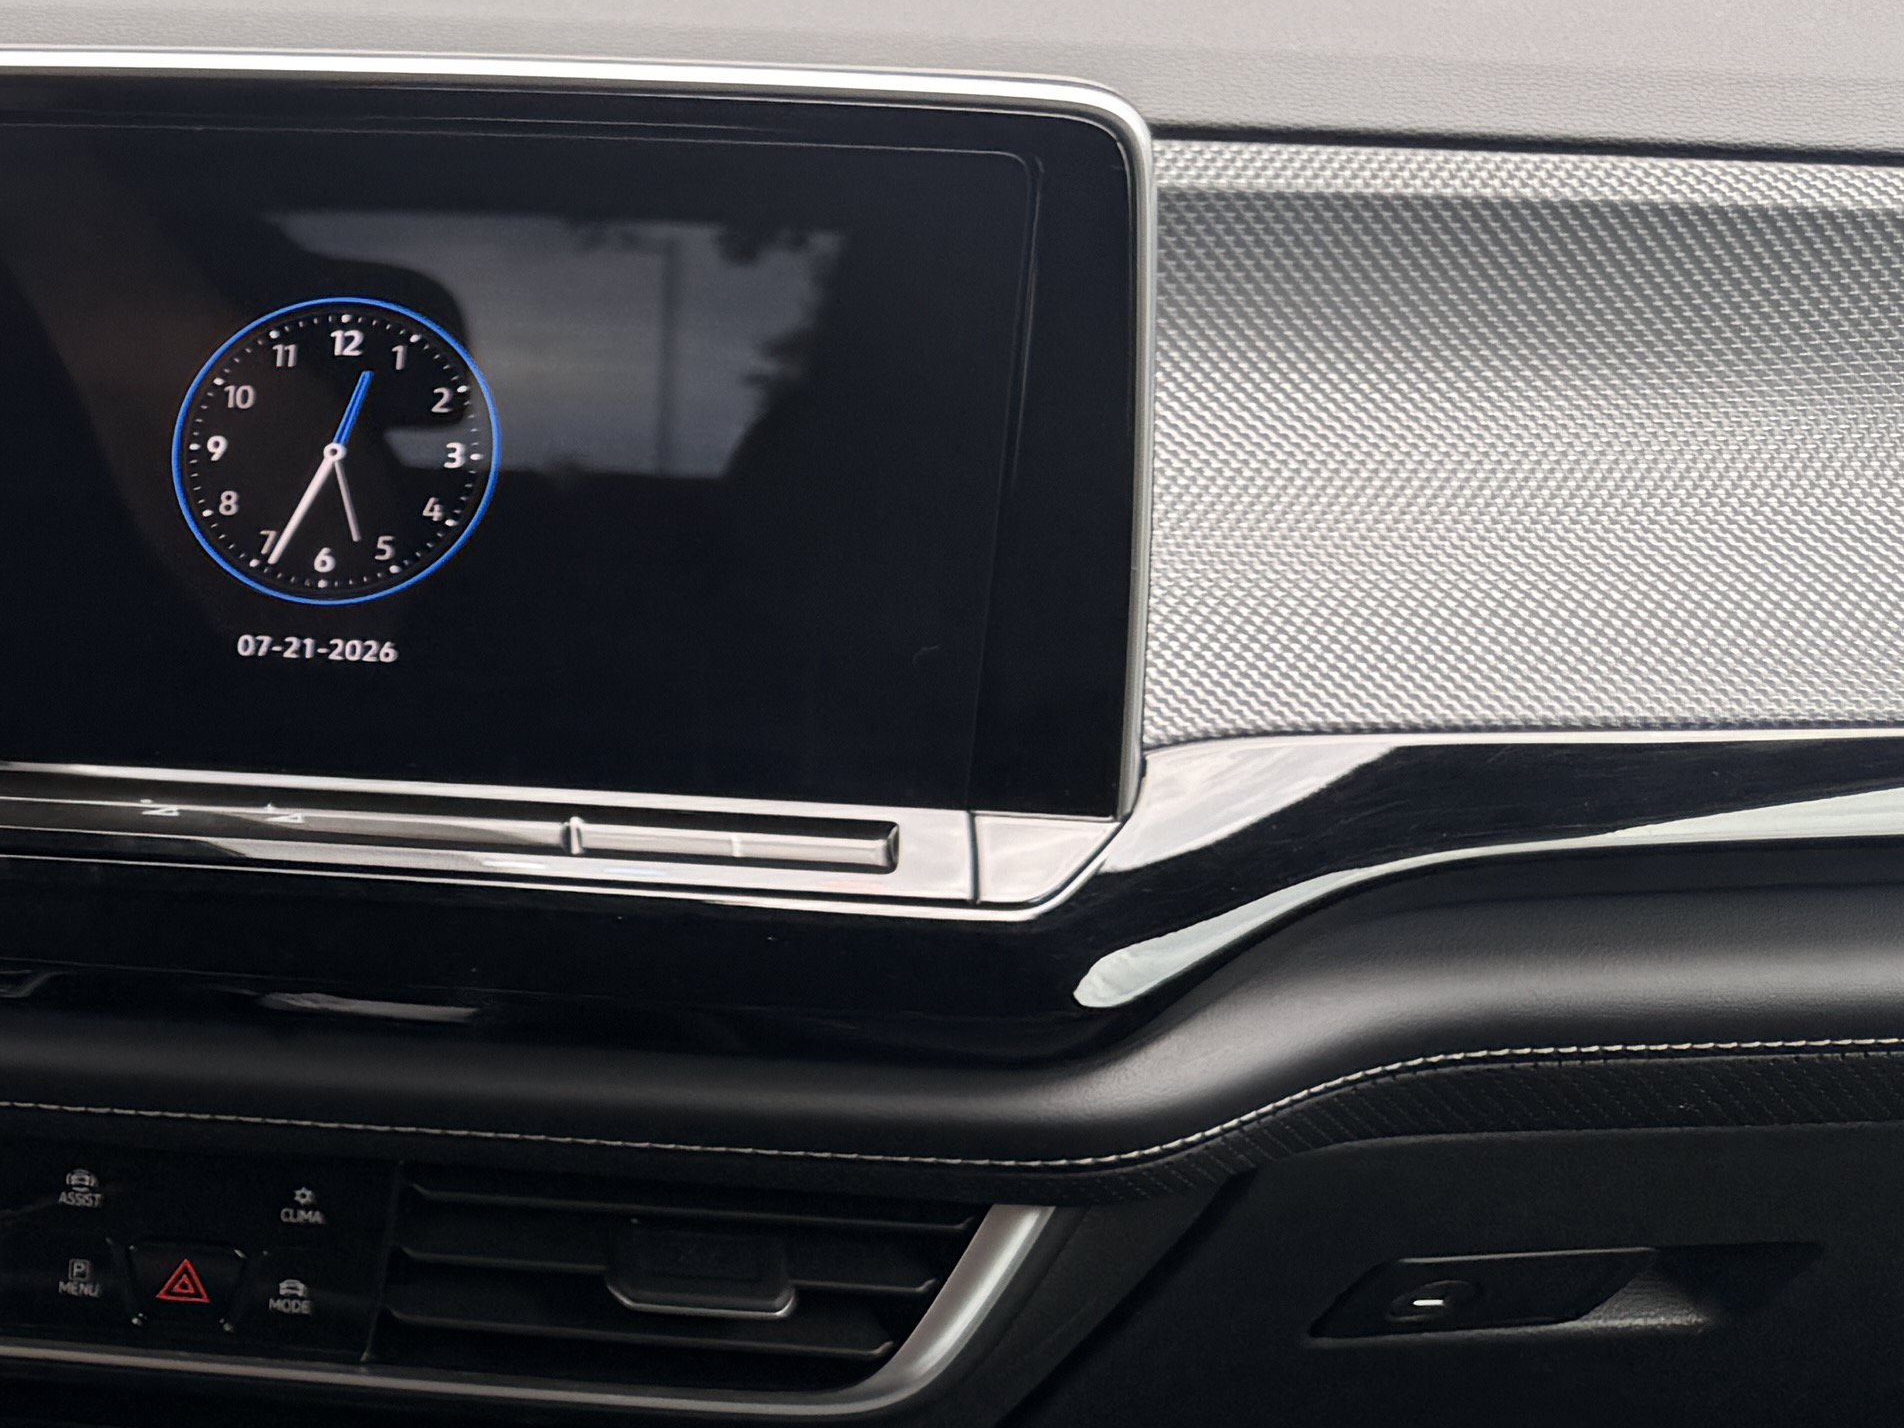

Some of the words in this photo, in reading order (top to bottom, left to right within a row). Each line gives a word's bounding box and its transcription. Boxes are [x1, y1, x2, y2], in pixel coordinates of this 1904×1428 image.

[331, 330, 363, 356] 12
[273, 344, 296, 367] 11
[392, 345, 404, 370] 1
[224, 385, 255, 409] 10
[432, 388, 450, 412] 2
[207, 436, 227, 461] 9
[444, 443, 464, 468] 3
[219, 491, 238, 515] 8
[423, 497, 442, 521] 4
[260, 530, 276, 553] 7
[375, 536, 393, 560] 5
[314, 548, 334, 572] 6
[238, 635, 397, 662] 07-21-2026
[58, 1191, 102, 1207] ASSIST
[280, 1209, 322, 1224] CLIMA
[59, 1282, 100, 1297] MENU
[269, 1299, 311, 1314] MODE
